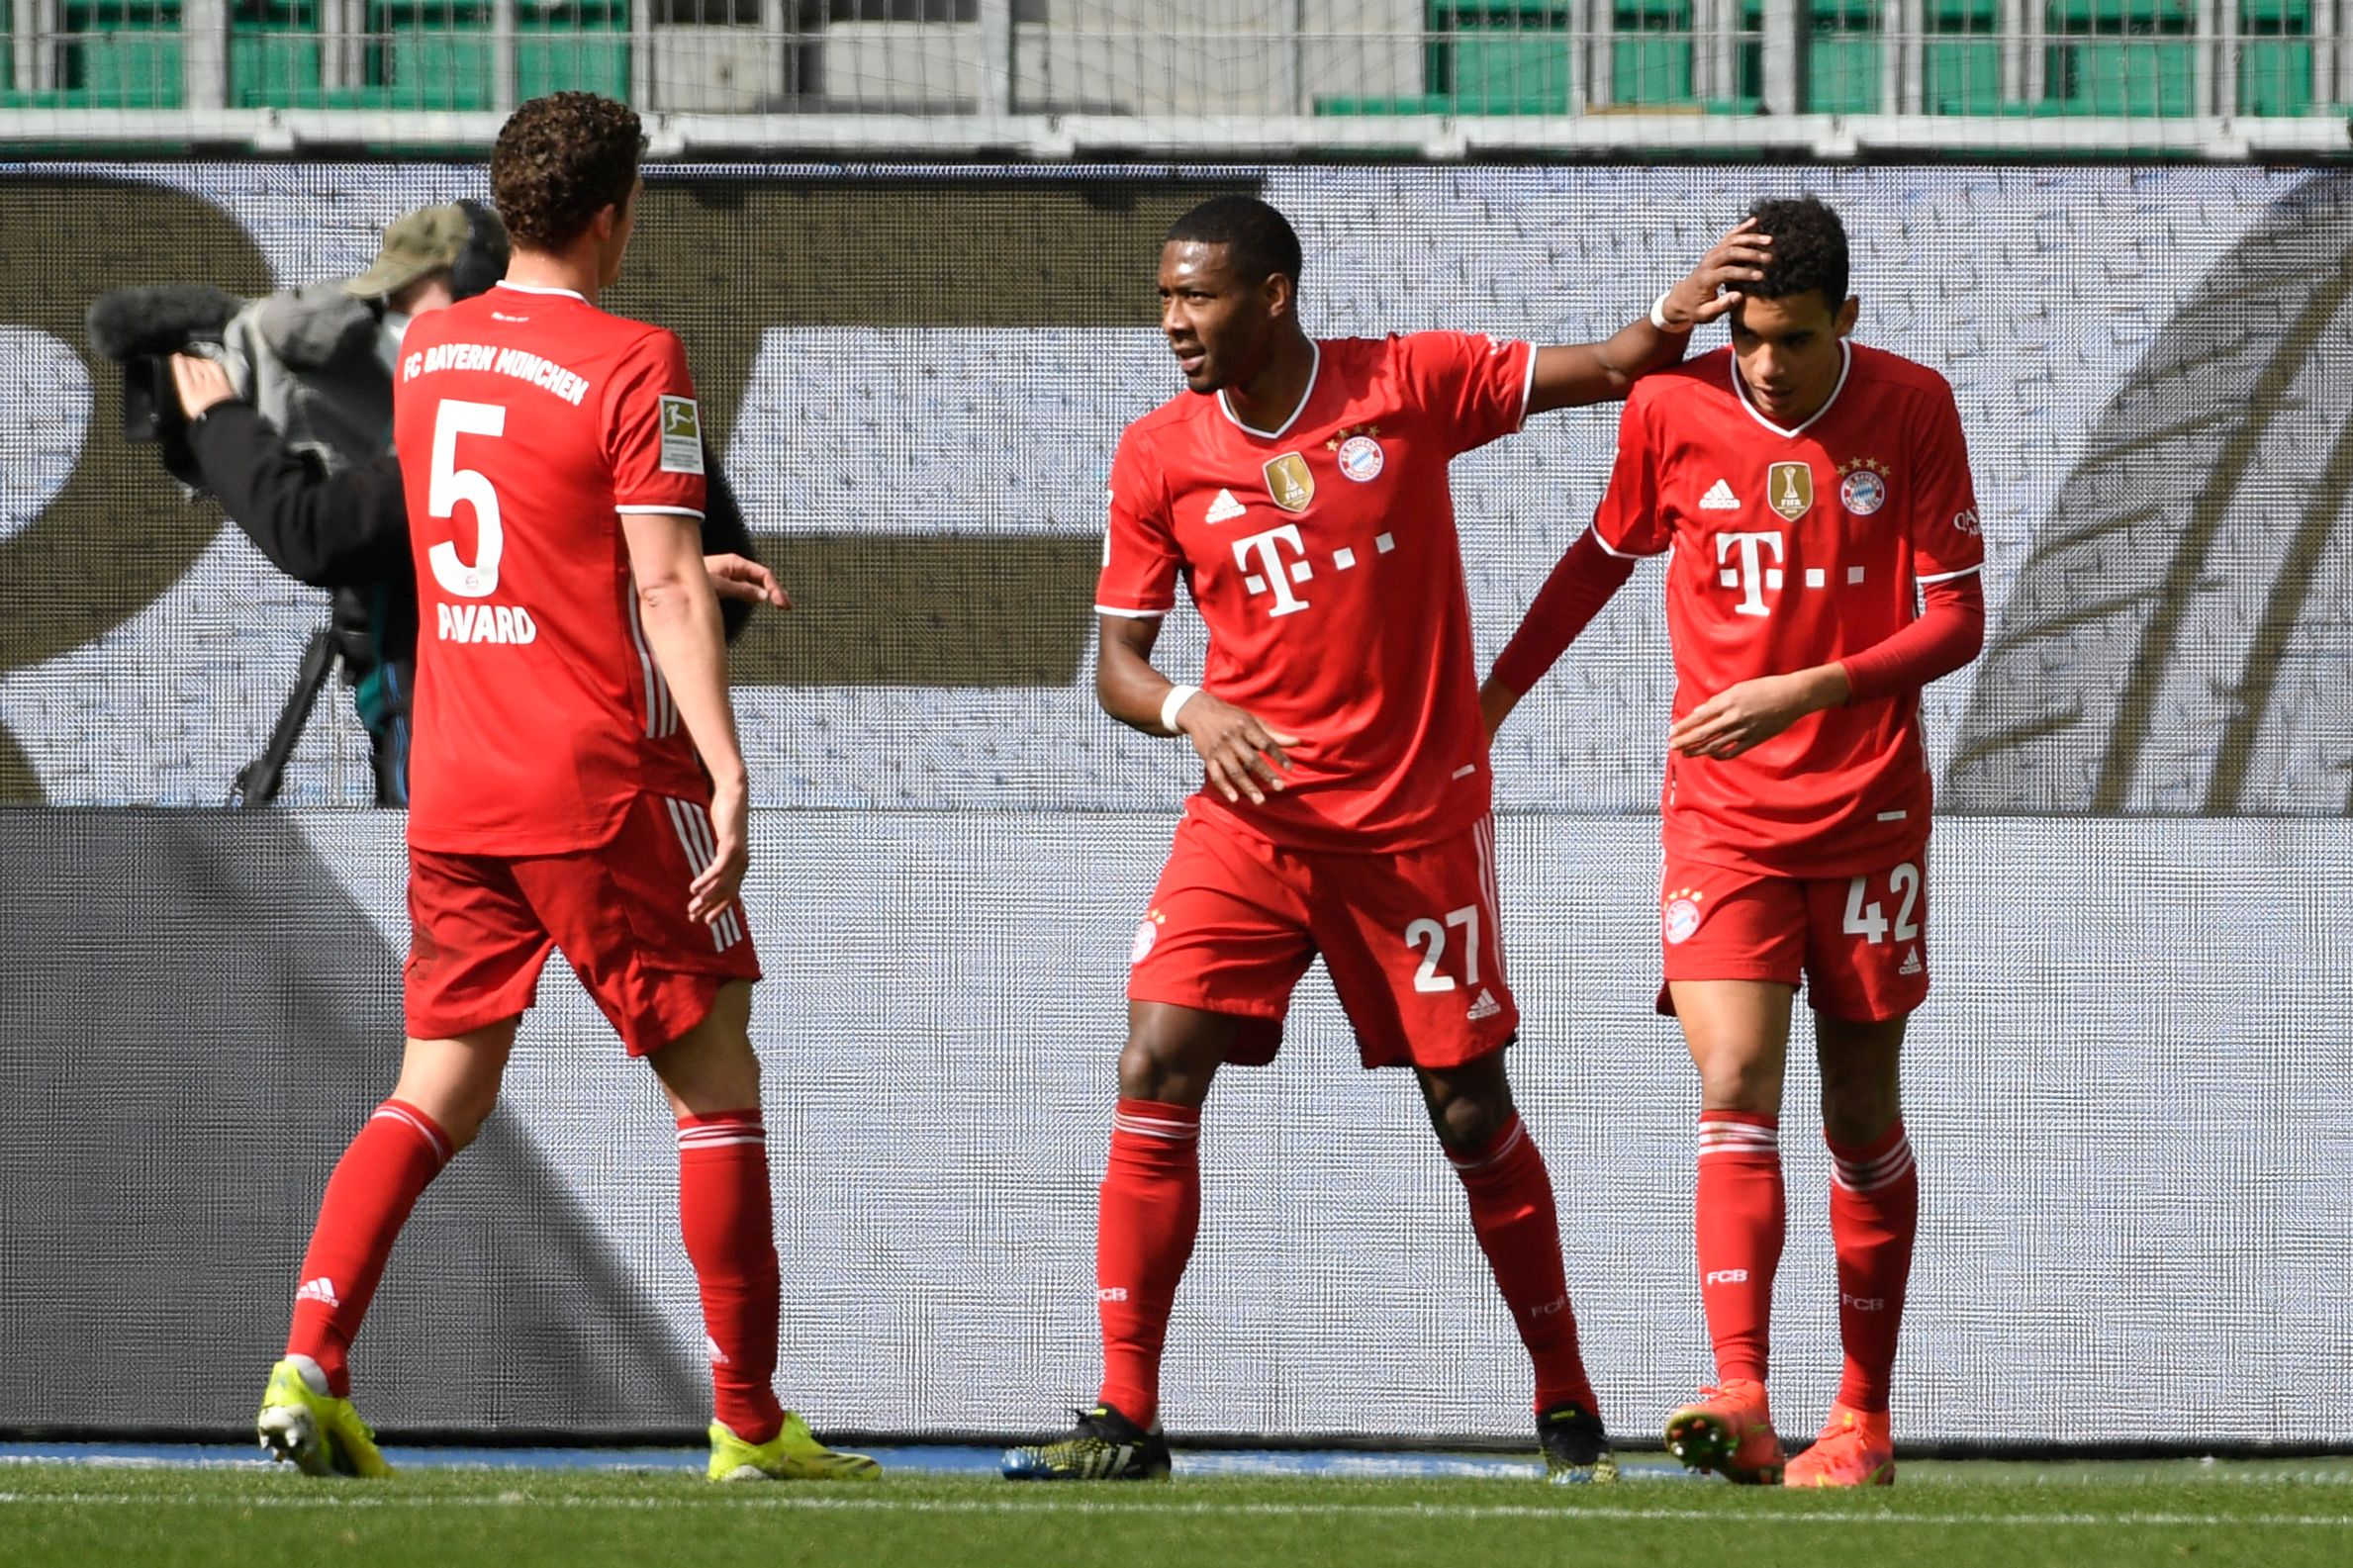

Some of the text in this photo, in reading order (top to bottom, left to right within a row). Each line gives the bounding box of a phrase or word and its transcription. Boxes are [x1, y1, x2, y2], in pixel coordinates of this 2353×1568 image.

[404, 352, 423, 383] FC
[424, 343, 497, 373] BAYERN
[428, 399, 506, 599] 5
[1698, 498, 1741, 510] adidas
[1843, 862, 1920, 944] 42
[1405, 904, 1480, 993] 27
[1707, 1268, 1748, 1285] FCB
[1842, 1293, 1884, 1311] FCB
